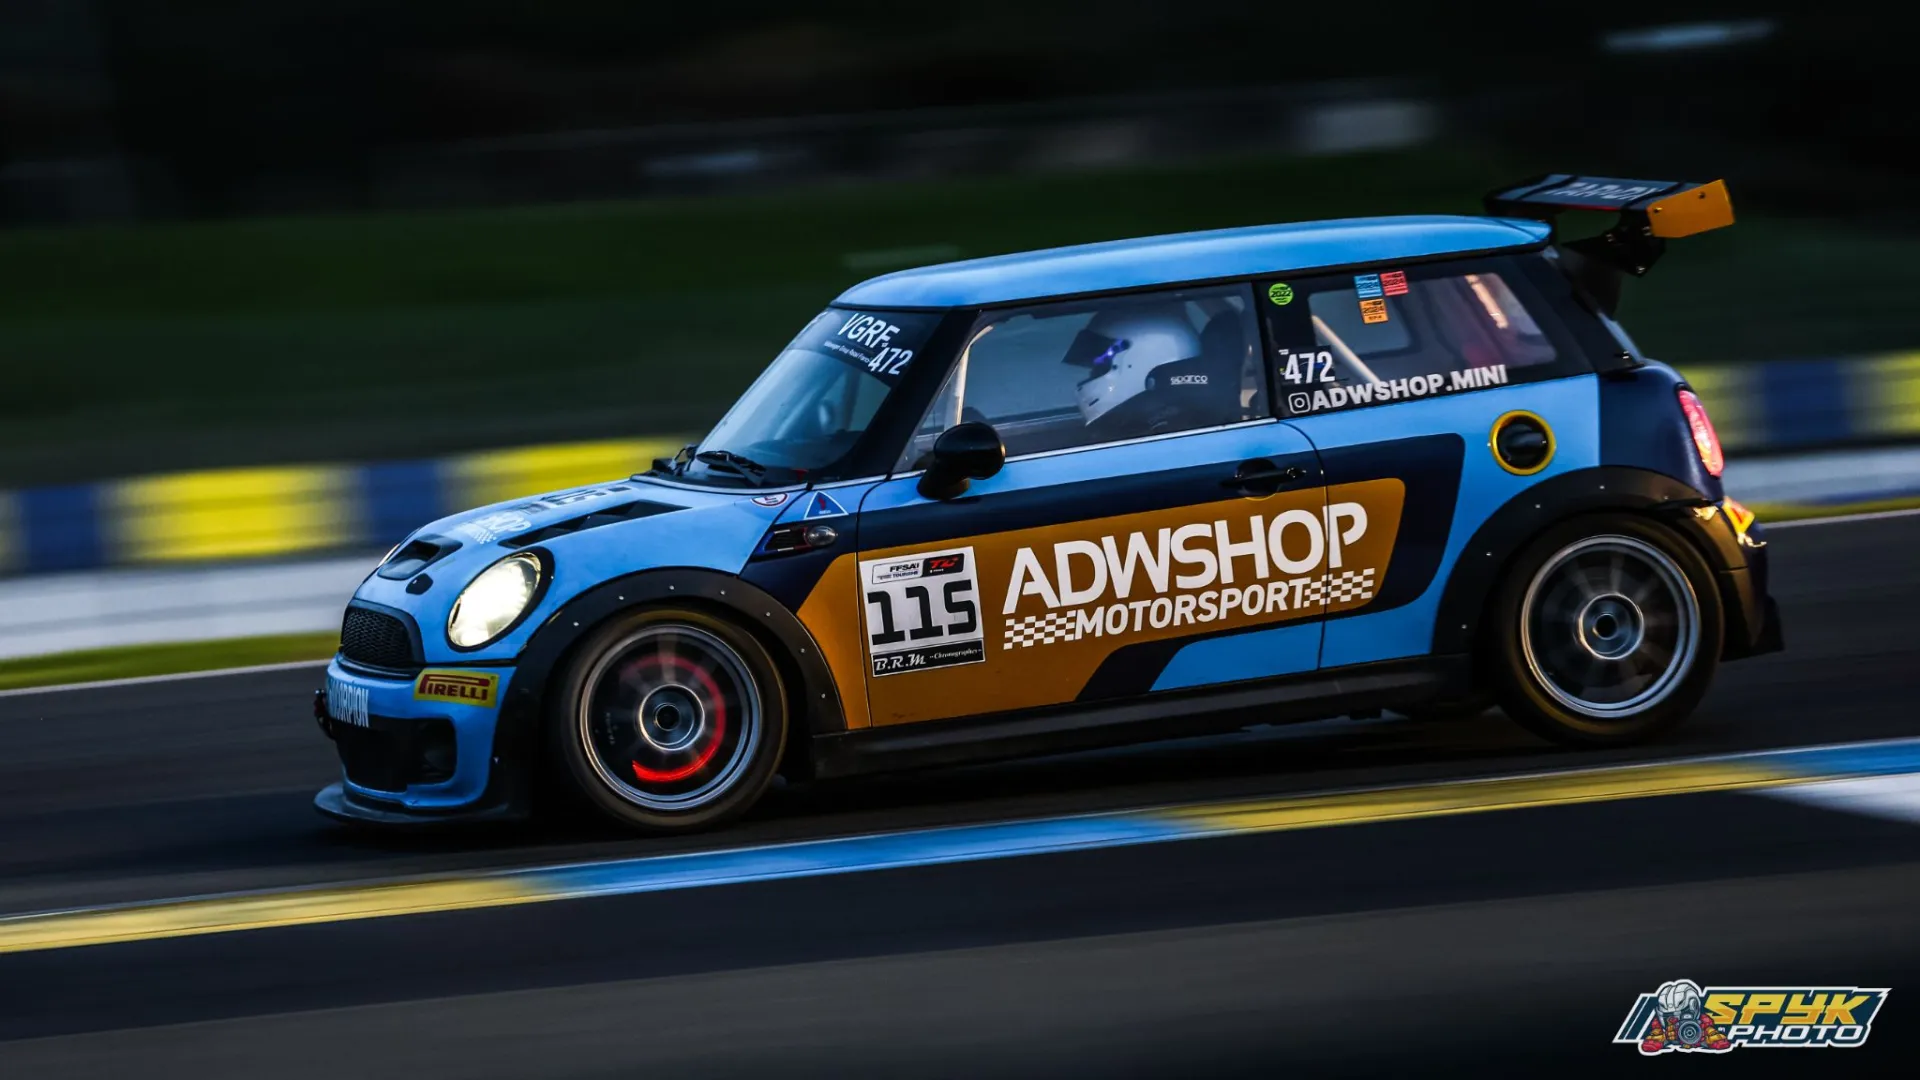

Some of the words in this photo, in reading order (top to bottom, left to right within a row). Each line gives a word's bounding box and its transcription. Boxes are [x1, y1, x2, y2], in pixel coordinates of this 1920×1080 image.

[837, 312, 901, 349] VGRF
[867, 347, 914, 375] 472
[1284, 351, 1336, 385] 472
[1170, 374, 1209, 386] sparco
[1311, 364, 1509, 411] ADWSHOP.MINI
[1002, 501, 1369, 615] ADWSHOP
[867, 579, 977, 646] 115
[1075, 577, 1311, 641] MOTORSPORT
[418, 674, 492, 701] PIRELLI
